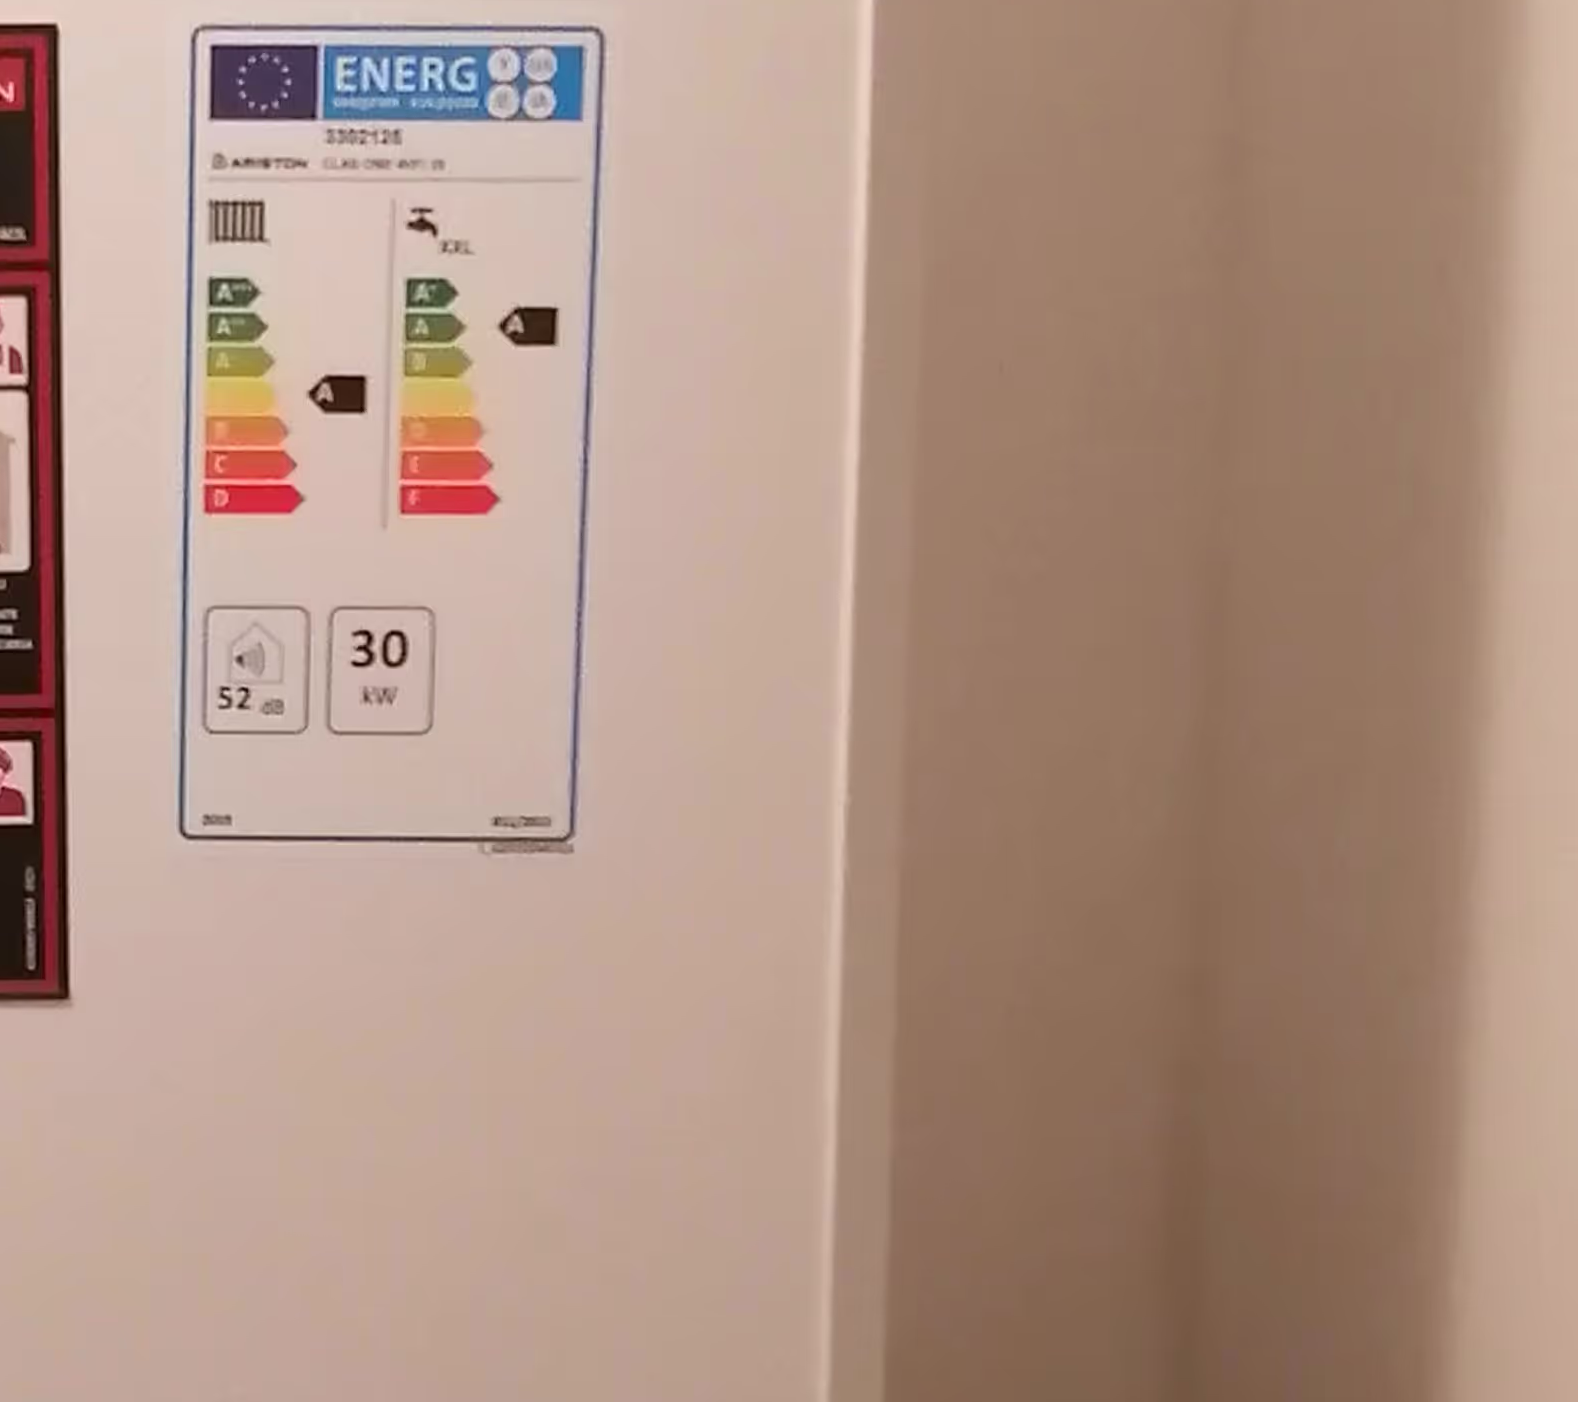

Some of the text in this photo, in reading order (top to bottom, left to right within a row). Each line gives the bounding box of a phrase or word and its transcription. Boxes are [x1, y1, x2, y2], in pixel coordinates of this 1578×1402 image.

[335, 55, 477, 92] ENERG
[232, 157, 309, 171] ARISTON
[505, 314, 524, 335] A
[315, 383, 334, 404] A
[214, 455, 227, 472] C
[214, 490, 230, 507] D
[350, 630, 409, 668] 30
[217, 686, 252, 711] 52
[359, 686, 399, 706] kW
[260, 699, 286, 715] dB
